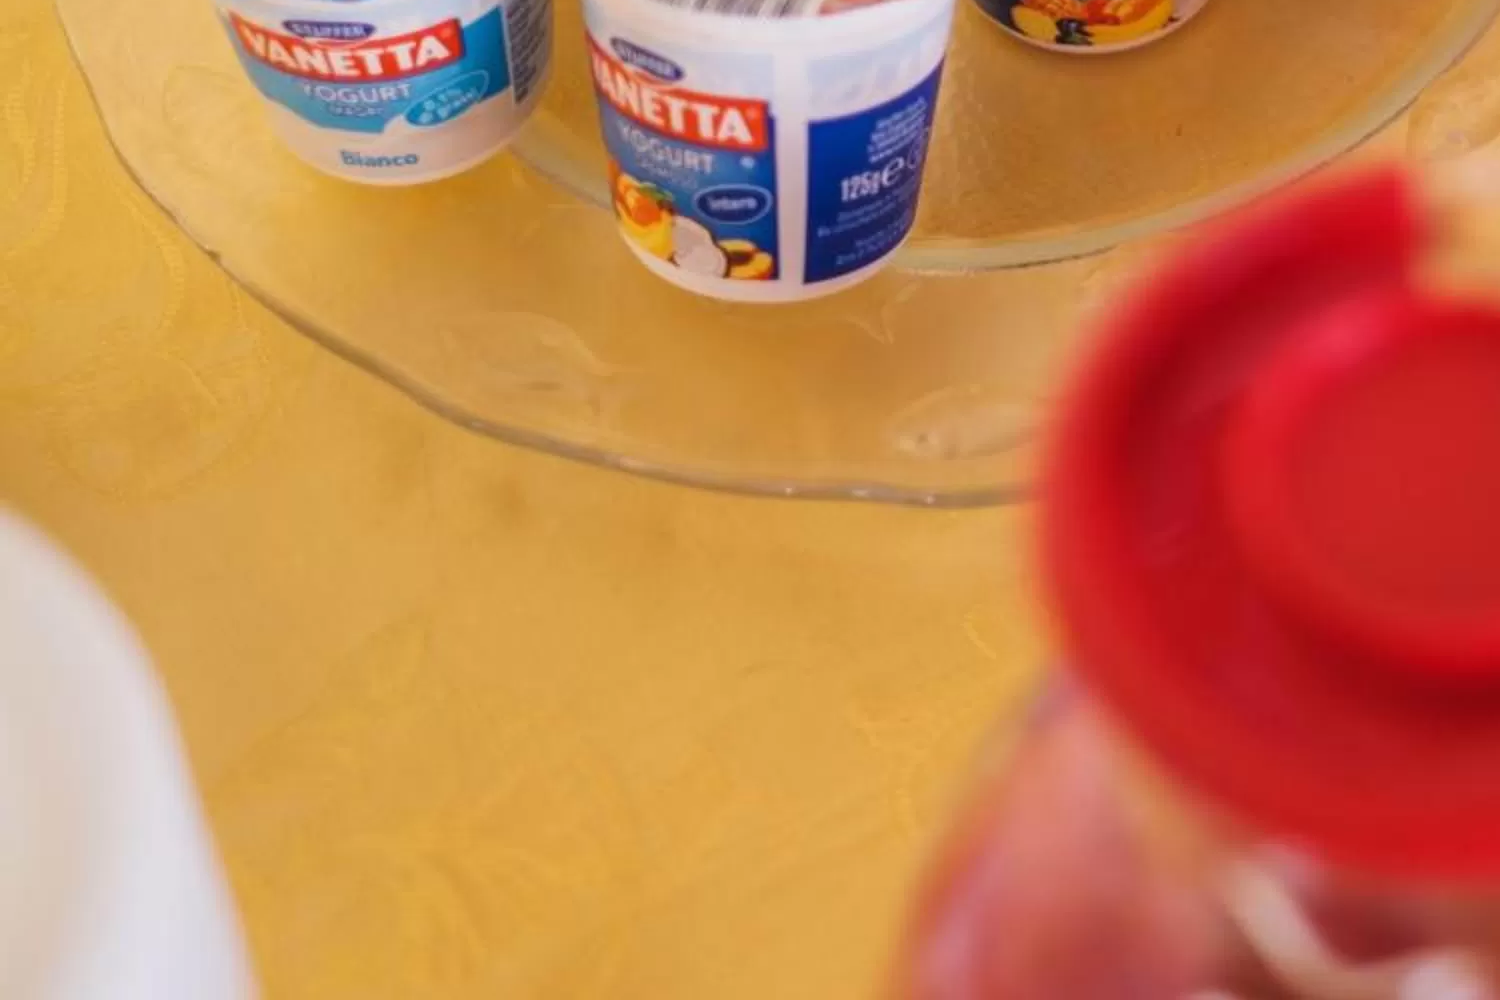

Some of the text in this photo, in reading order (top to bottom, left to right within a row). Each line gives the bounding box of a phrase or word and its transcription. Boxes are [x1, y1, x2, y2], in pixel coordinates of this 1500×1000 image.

[243, 34, 450, 77] VANETTA
[302, 83, 412, 104] YOGURT
[591, 52, 753, 145] ANETTA
[616, 118, 714, 175] YOGURT
